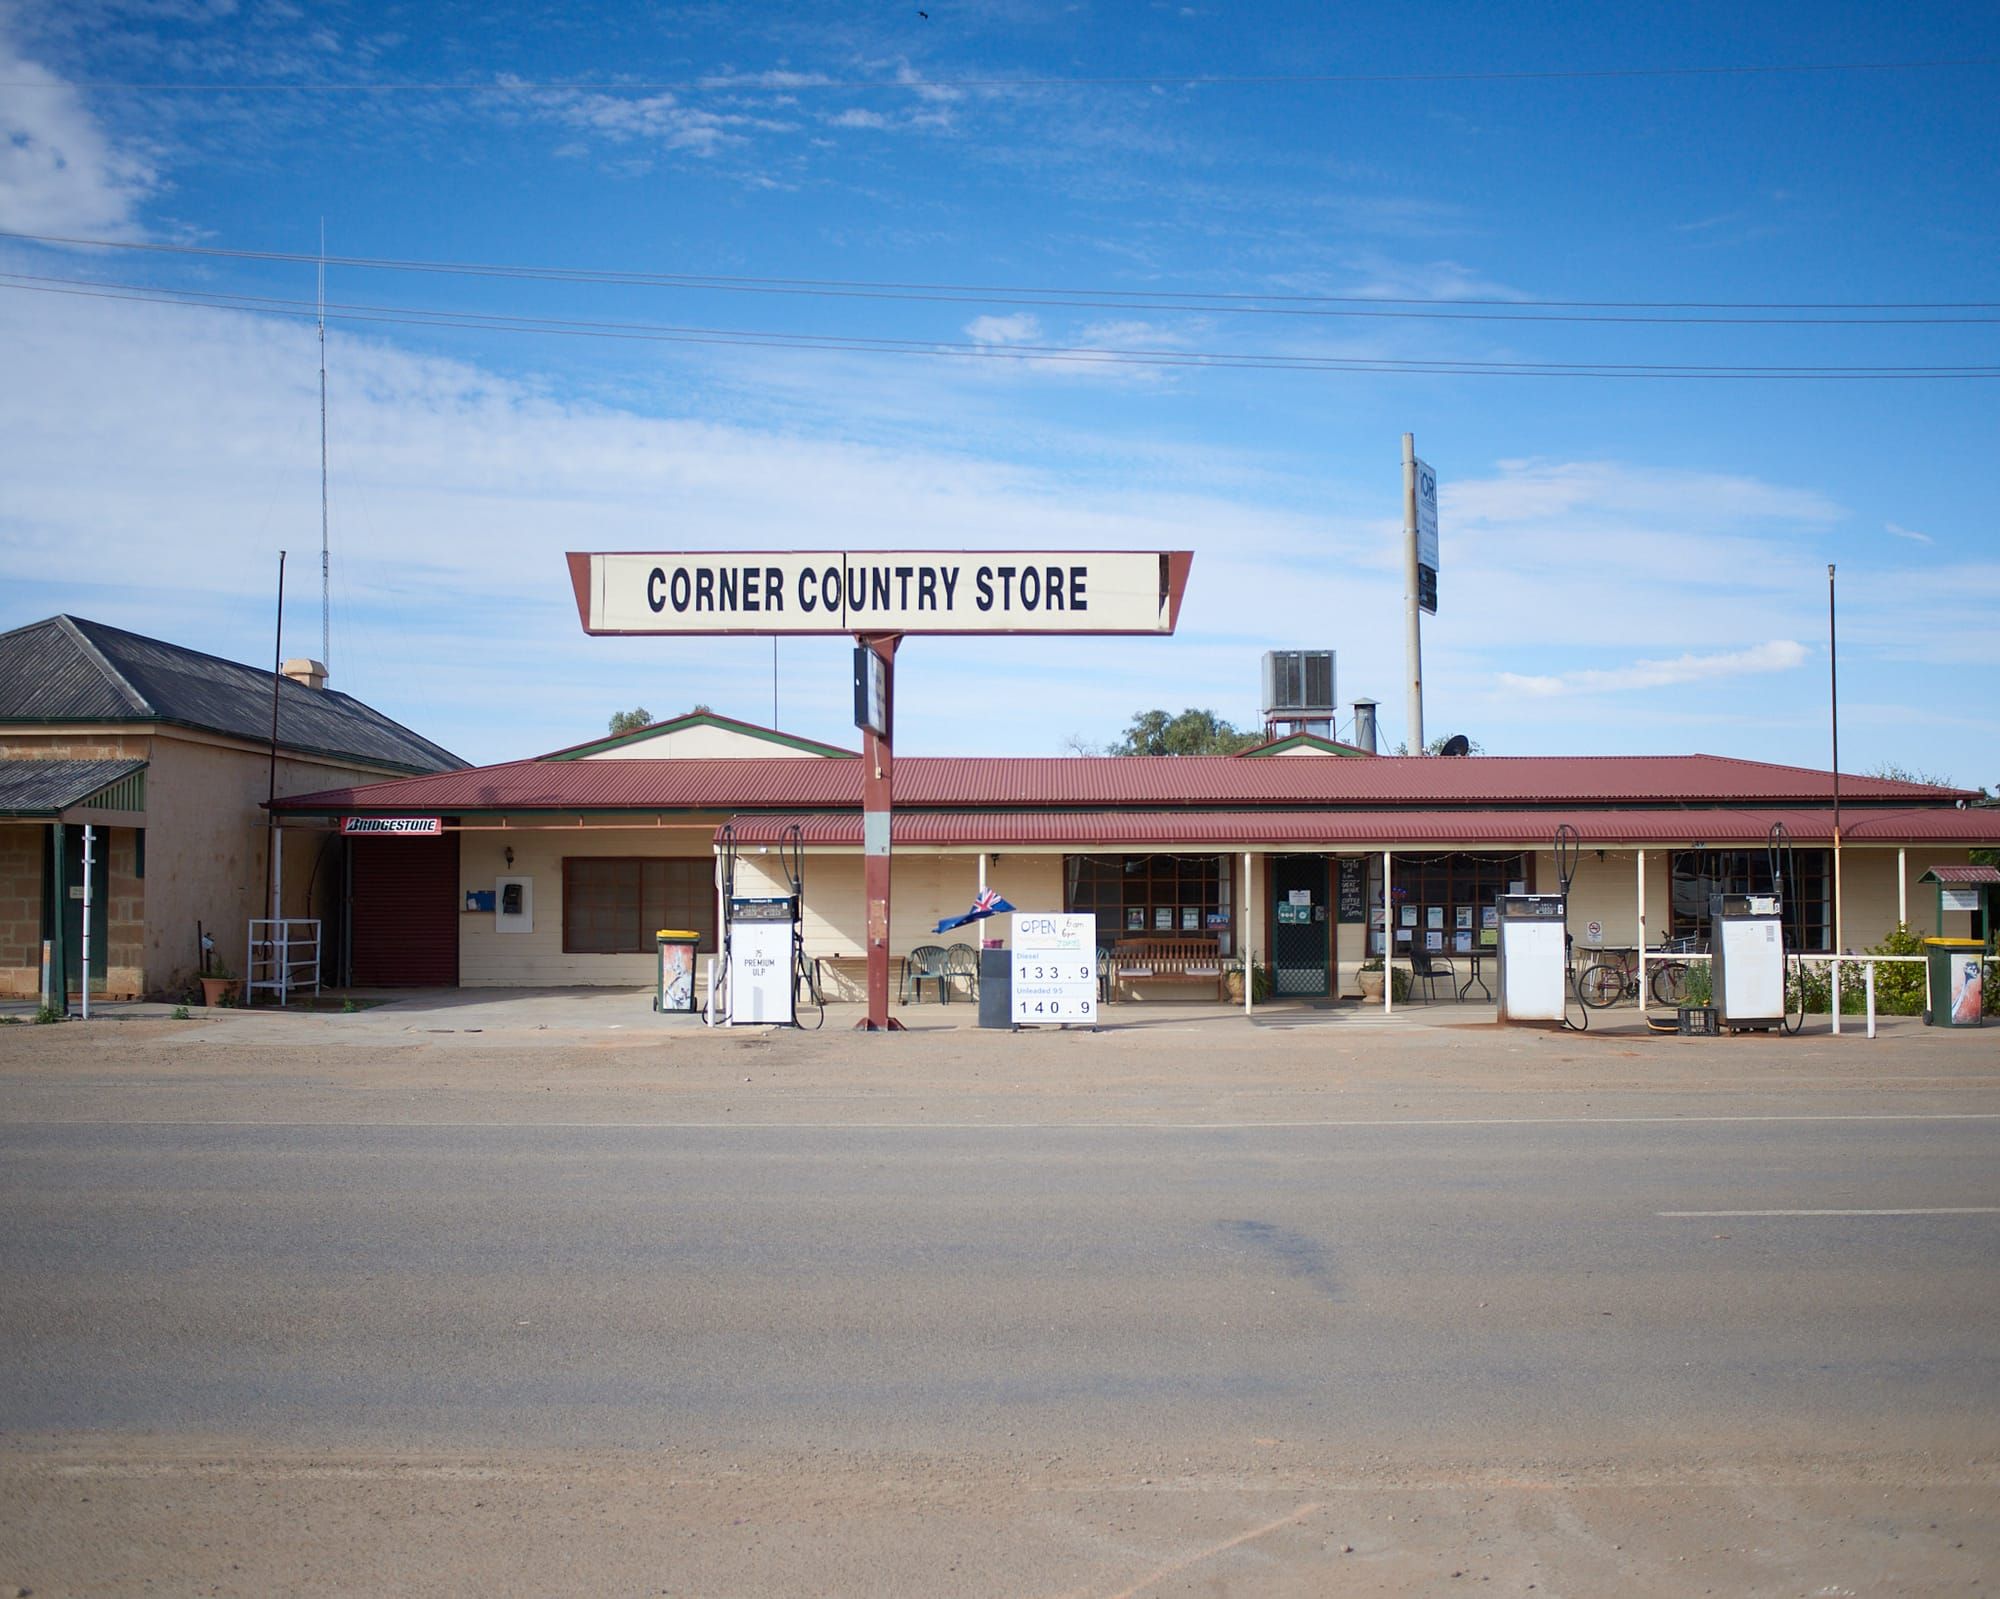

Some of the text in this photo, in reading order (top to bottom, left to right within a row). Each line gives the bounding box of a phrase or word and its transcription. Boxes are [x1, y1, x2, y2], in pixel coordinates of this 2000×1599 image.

[646, 566, 1089, 613] CORNER COUNTRY STORE
[346, 817, 437, 832] BRIDGESTONE
[1021, 920, 1057, 934] OPEN
[744, 959, 775, 968] PREMIUM
